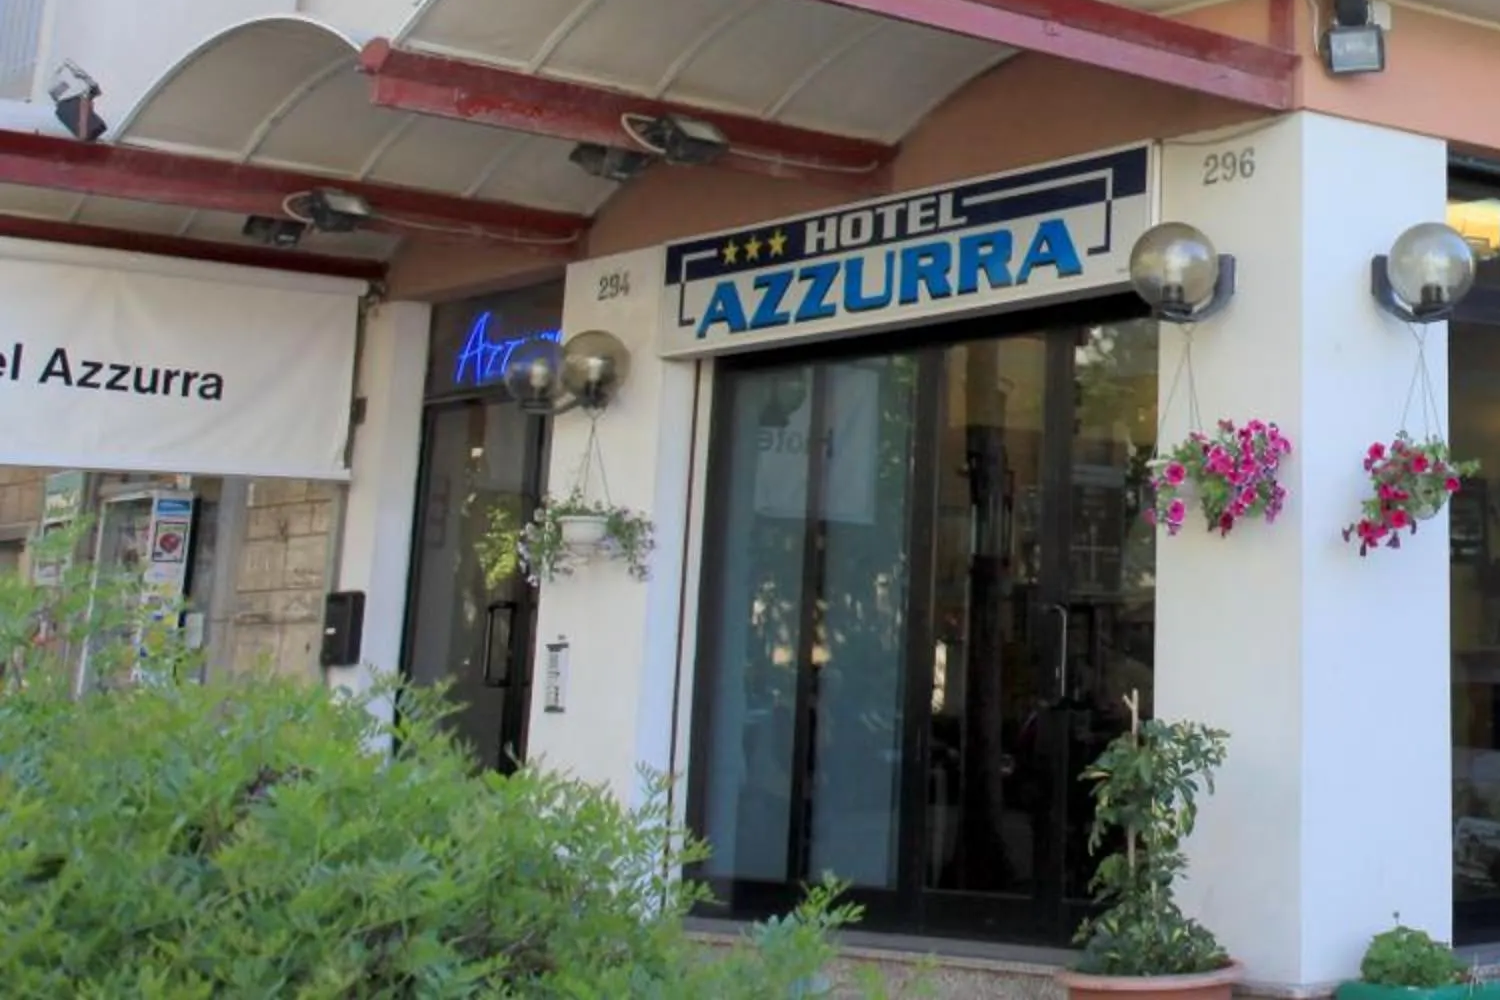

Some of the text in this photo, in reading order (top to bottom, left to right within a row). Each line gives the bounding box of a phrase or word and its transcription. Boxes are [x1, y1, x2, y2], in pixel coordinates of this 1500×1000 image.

[1203, 146, 1256, 185] 296
[804, 192, 967, 254] HOTEL
[597, 271, 631, 301] 294
[696, 218, 1083, 339] AZZURRA
[38, 347, 224, 401] Azzurra
